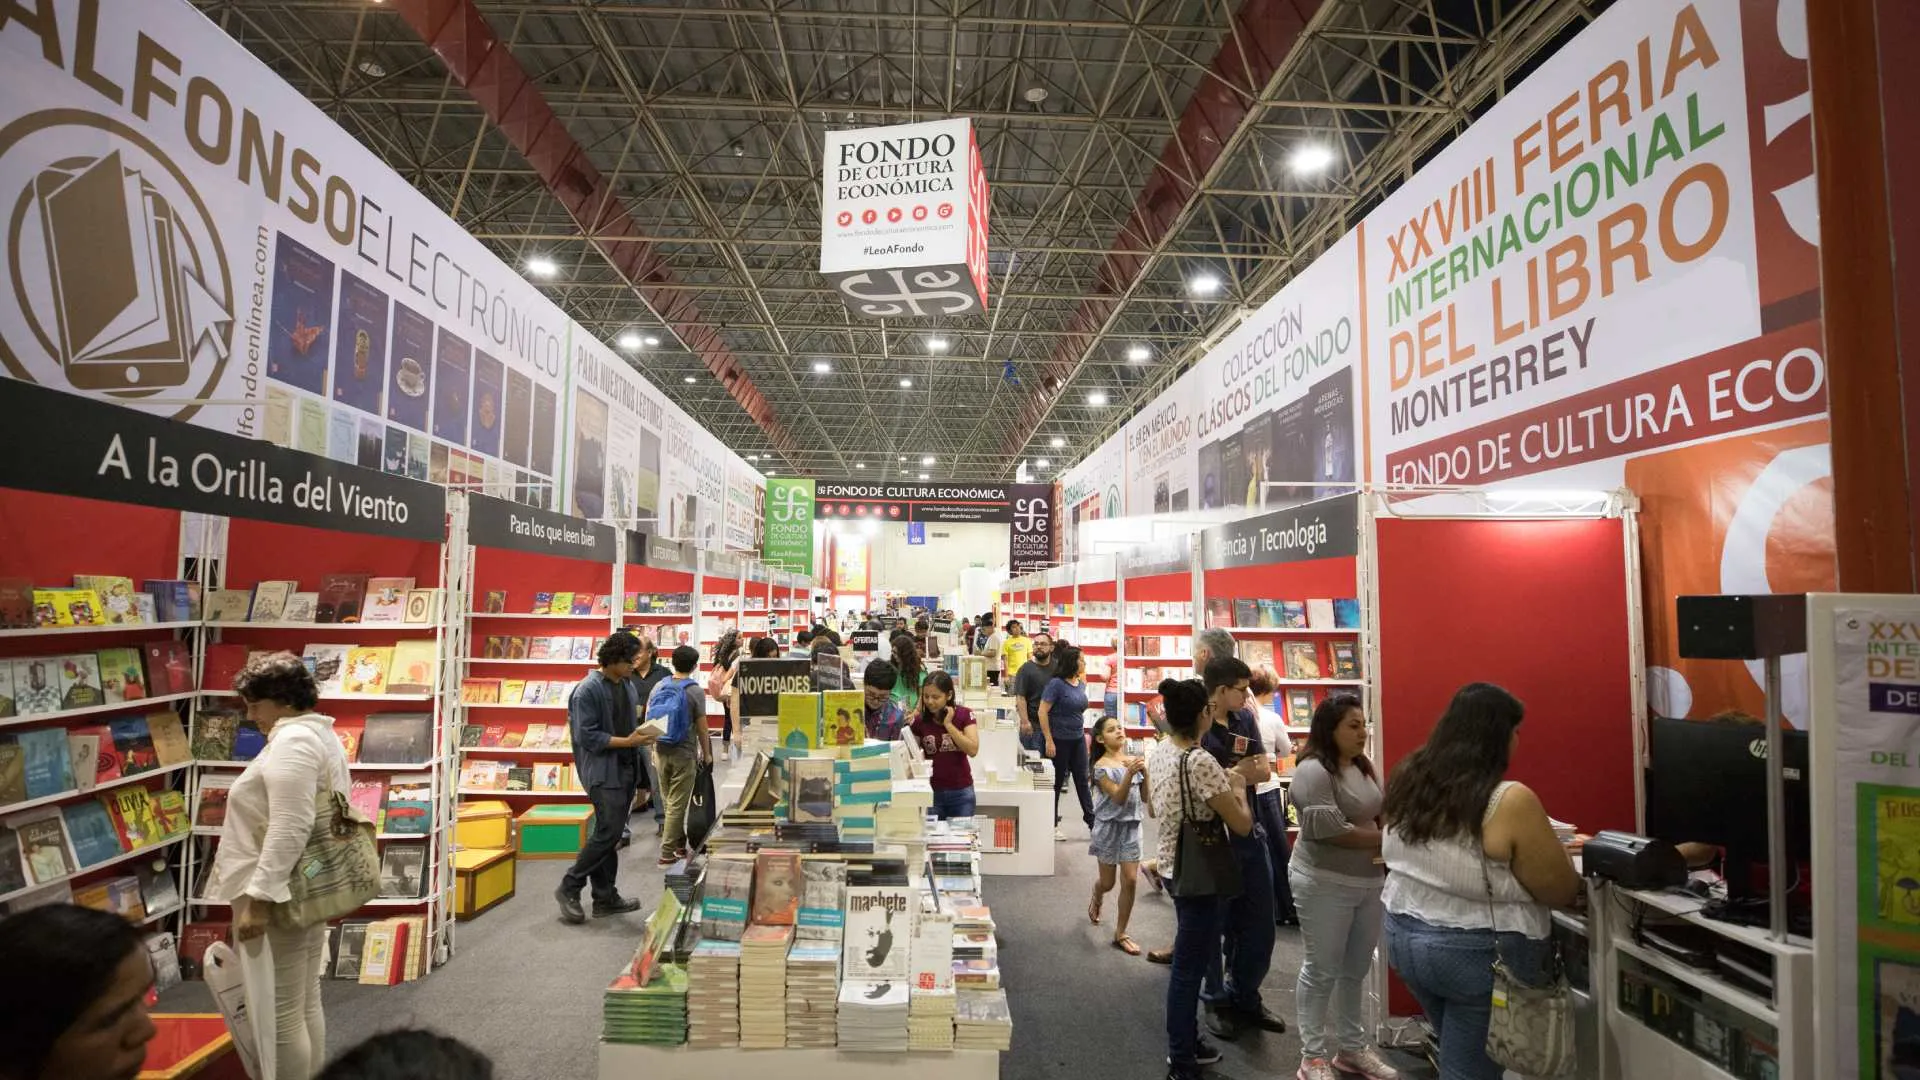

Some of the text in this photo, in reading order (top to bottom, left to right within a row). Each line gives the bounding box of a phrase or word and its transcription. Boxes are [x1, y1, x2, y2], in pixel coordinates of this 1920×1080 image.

[839, 133, 955, 166] FONDO
[1387, 3, 1720, 283] XXVIII FERIA
[838, 159, 954, 183] DE CULTURA
[837, 177, 954, 200] ECONÓMICA
[1388, 92, 1725, 327] INTERNACIONAL
[863, 243, 924, 256] #LeoAFondo
[1390, 162, 1730, 392] DEL LIBRO
[1222, 304, 1303, 388] COLECCIÓN
[577, 345, 599, 388] PARA
[1197, 382, 1251, 438] CLÁSICOS
[1254, 367, 1280, 406] DEL
[1283, 316, 1351, 390] FONDO
[1391, 317, 1596, 435] MONTERREY
[1392, 348, 1825, 486] FONDO DE CULTURA ECO
[98, 434, 409, 524] A la Orilla del Viento
[827, 485, 867, 496] FONDO
[869, 487, 884, 496] DE
[886, 487, 936, 498] CULTURA
[938, 486, 1005, 499] ECONÓMICA
[510, 515, 595, 547] Para los que leen bien
[770, 524, 808, 534] FONDO
[1013, 534, 1049, 544] FONDO
[1250, 535, 1257, 560] y
[1260, 517, 1327, 554] Tecnología
[854, 636, 878, 644] OFERTAS
[740, 675, 810, 694] NOVEDADES
[1871, 751, 1911, 767] DEL
[850, 890, 907, 912] machete
